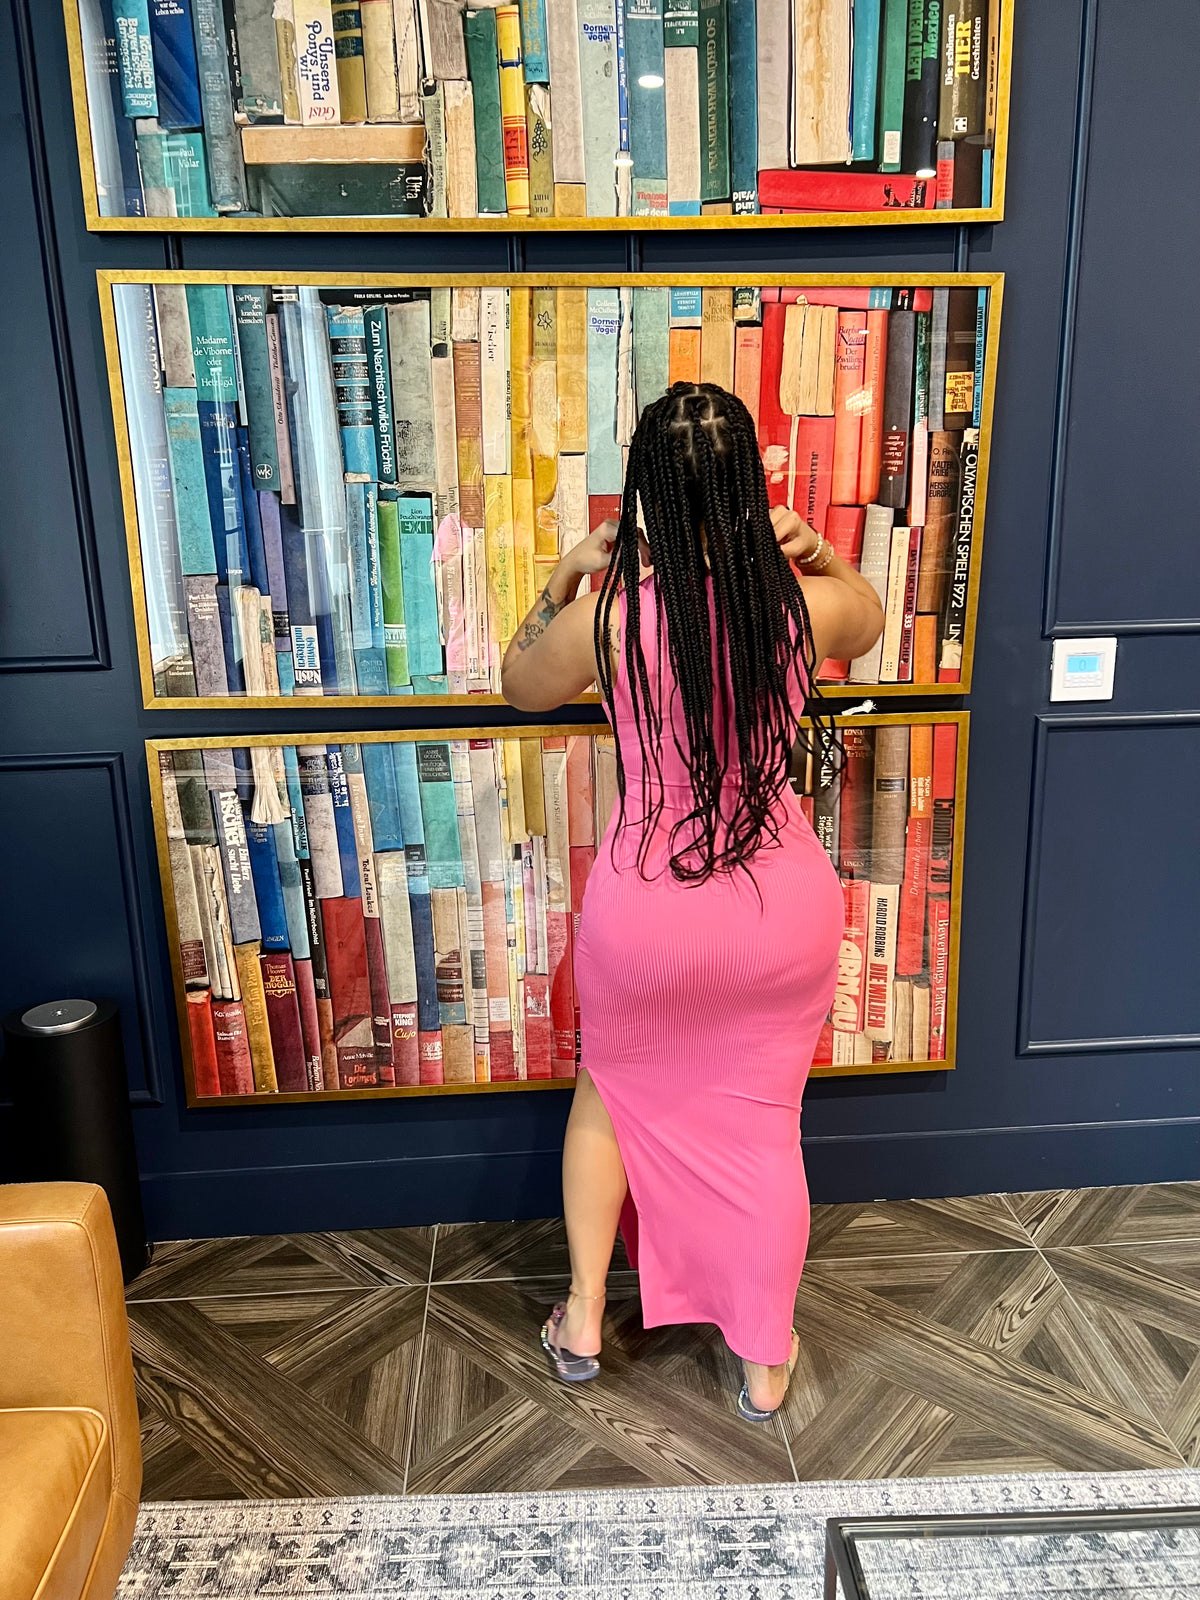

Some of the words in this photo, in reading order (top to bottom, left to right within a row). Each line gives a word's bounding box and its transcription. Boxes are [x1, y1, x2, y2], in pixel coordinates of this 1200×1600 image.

[583, 24, 614, 33] Dornen
[588, 32, 611, 41] vogel
[706, 18, 716, 38] SO
[924, 1, 939, 60] Mexico
[945, 14, 956, 63] schönsten
[127, 17, 143, 89] Bayerisches
[308, 20, 322, 72] Ponys
[955, 20, 972, 75] TIER
[971, 17, 982, 80] Geschichten
[135, 35, 154, 89] Königlich
[300, 55, 309, 80] wir
[321, 37, 333, 92] Unsere
[706, 40, 718, 78] GRÜN
[909, 58, 922, 81] LEN
[312, 73, 323, 101] und
[944, 66, 954, 86] Die
[405, 175, 422, 199] Utta
[736, 202, 754, 212] und
[371, 321, 382, 345] Zum
[592, 318, 620, 326] Dornen
[595, 326, 617, 334] vogel
[194, 347, 203, 356] de
[196, 336, 228, 345] Madame
[206, 358, 222, 366] oder
[374, 348, 386, 397] Nachtisch
[379, 399, 389, 433] wilde
[380, 433, 392, 474] Früchte
[809, 452, 818, 484] JULIAN
[807, 485, 817, 515] GLOAG
[959, 454, 977, 542] OLYMPISCHEN
[955, 544, 969, 580] SPIELE
[952, 583, 965, 609] 1972
[904, 614, 913, 628] 333
[294, 627, 304, 642] und
[295, 643, 306, 667] Regen
[307, 637, 317, 668] Ostwind
[294, 670, 321, 683] Nash
[218, 791, 241, 847] Fischer
[826, 816, 834, 833] Heiß
[228, 848, 236, 869] sucht
[239, 848, 247, 862] Ein
[362, 859, 370, 872] Tod
[231, 870, 241, 894] Liebe
[240, 863, 249, 880] Herz
[876, 897, 888, 924] HAROLD
[874, 926, 886, 958] ROBBINS
[935, 919, 949, 984] Bewerbungs
[269, 975, 286, 983] DER
[870, 963, 888, 982] DIE
[867, 982, 888, 1028] WILDEN
[934, 986, 946, 1016] Paket
[395, 1028, 416, 1040] Cujo
[354, 1065, 367, 1073] Die
